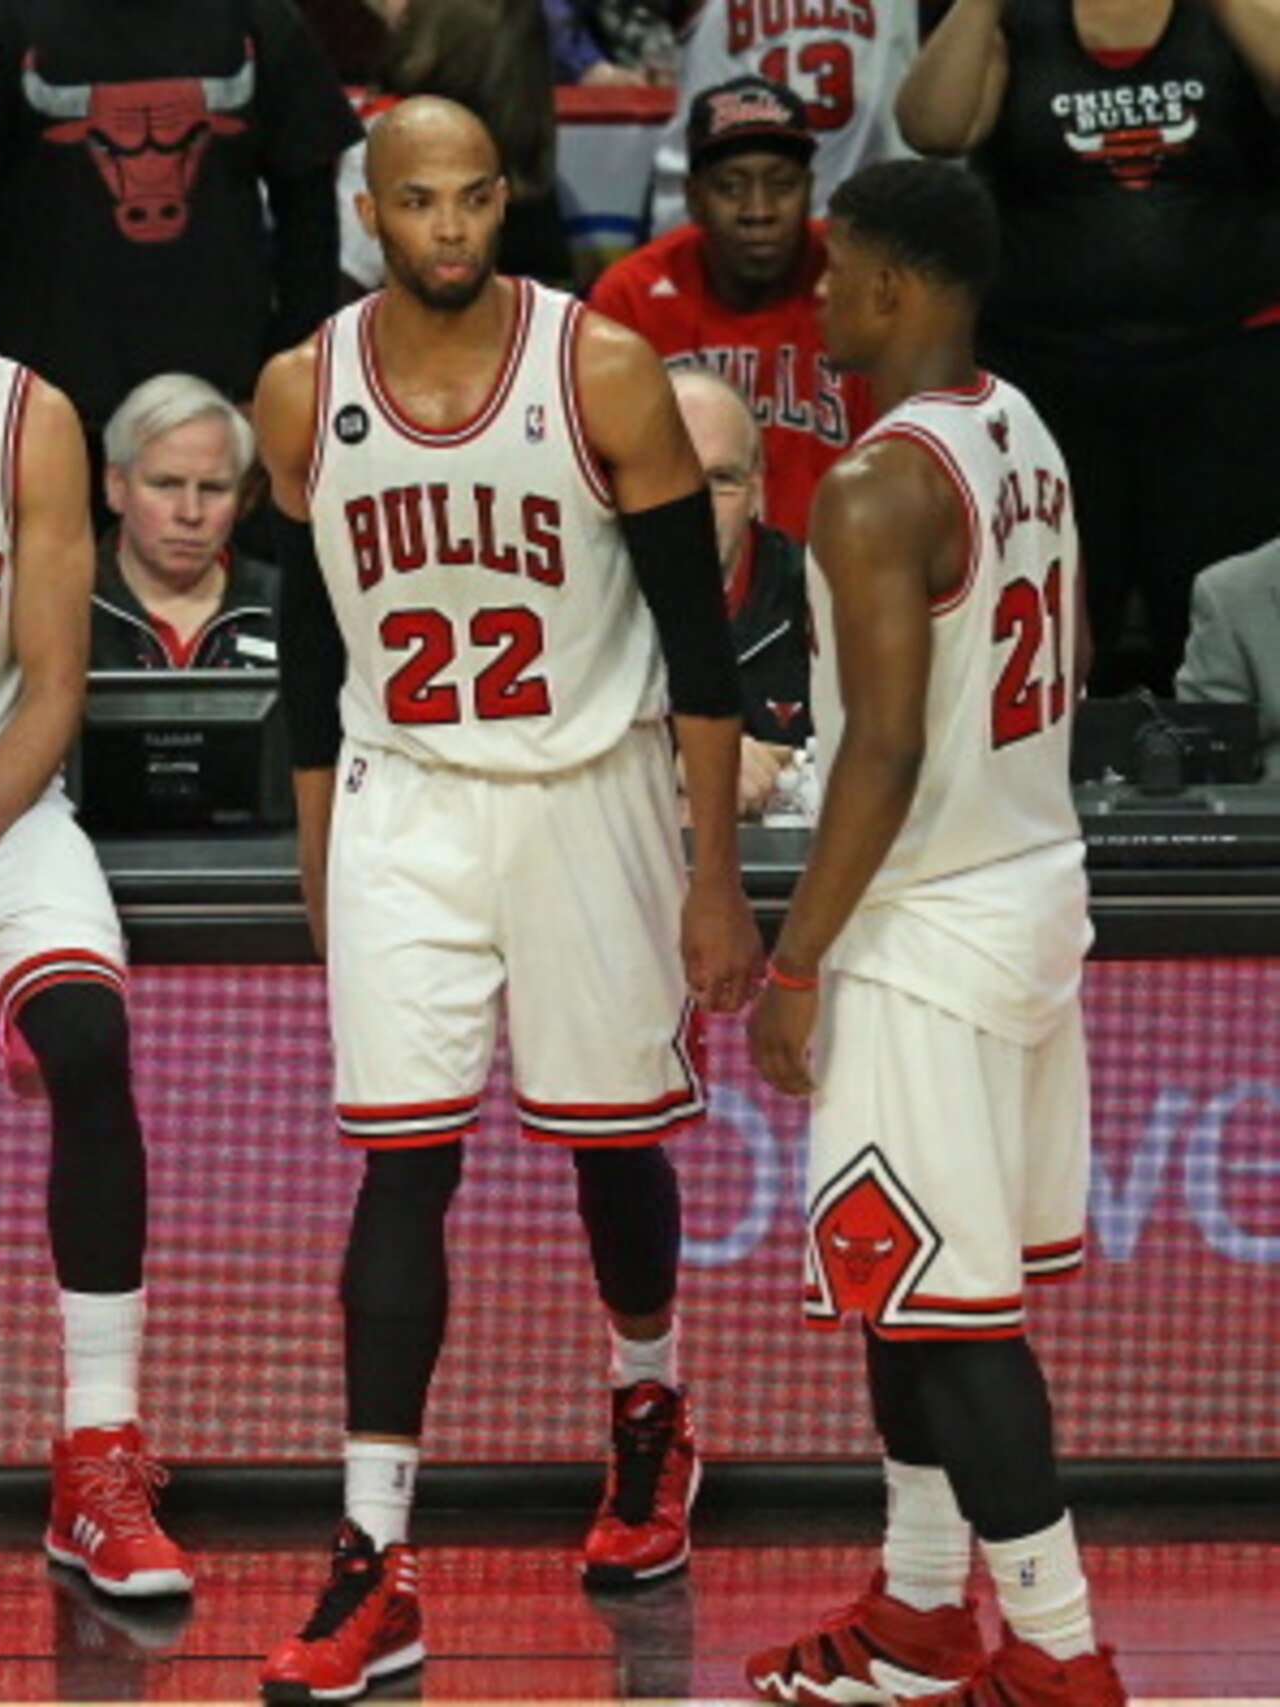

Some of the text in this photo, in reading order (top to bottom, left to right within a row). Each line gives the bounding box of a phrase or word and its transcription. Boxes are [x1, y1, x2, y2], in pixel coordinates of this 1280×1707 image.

[1051, 79, 1205, 116] CHICAGO
[1076, 100, 1183, 132] BULLS
[344, 483, 565, 592] BULLS
[378, 605, 552, 725] 22
[990, 557, 1066, 751] 21
